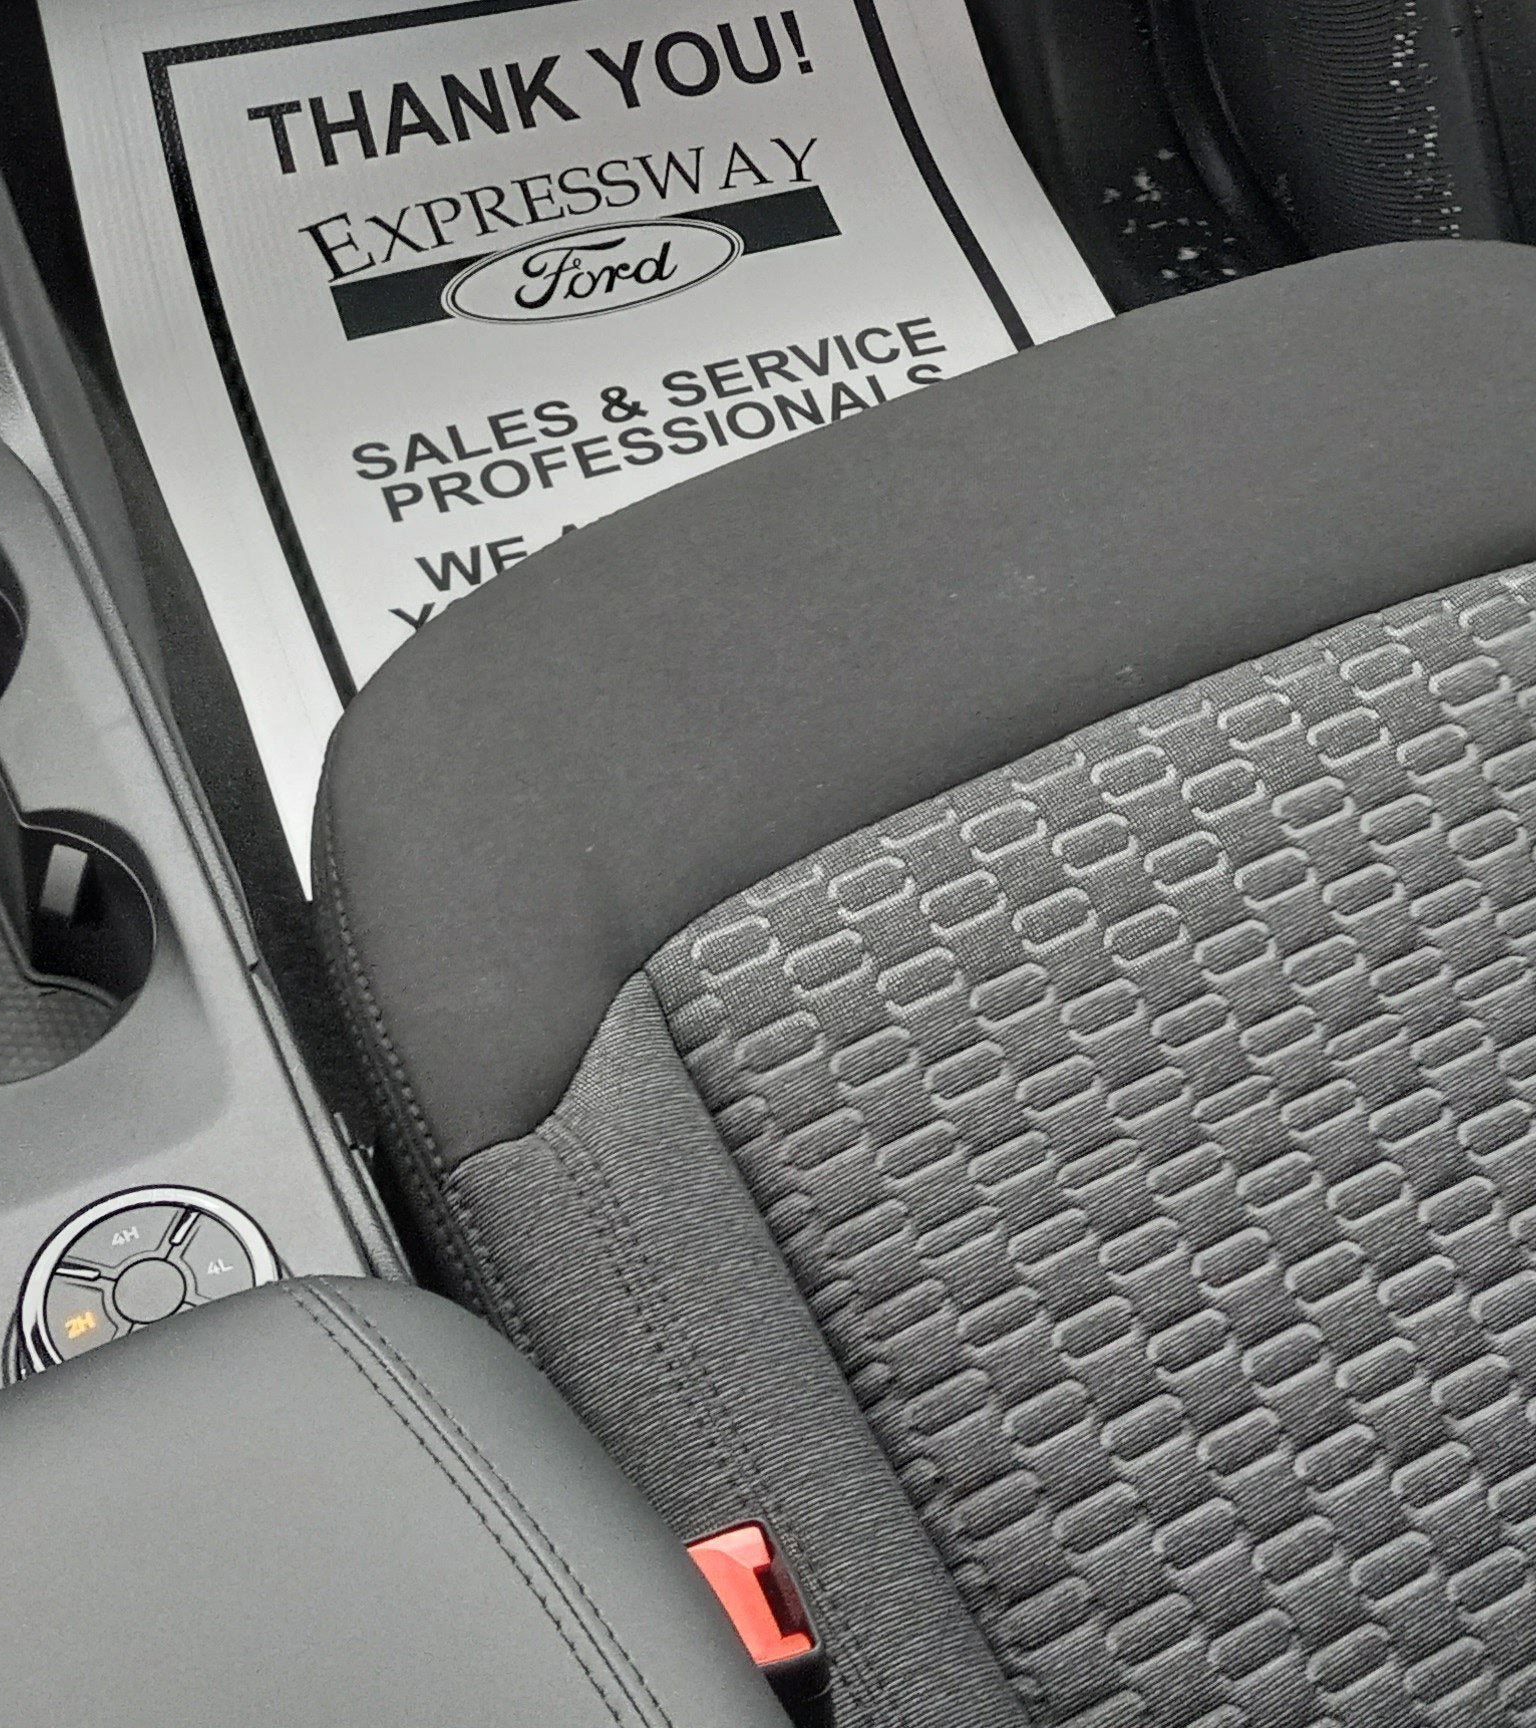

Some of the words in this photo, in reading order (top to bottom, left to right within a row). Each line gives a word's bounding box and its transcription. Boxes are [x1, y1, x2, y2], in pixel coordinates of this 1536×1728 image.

[247, 54, 581, 175] THANK
[585, 9, 814, 108] YOU!
[298, 136, 819, 284] EXPRESSWAY
[512, 237, 678, 311] Ford
[352, 399, 579, 481] SALES
[599, 385, 649, 424] &
[662, 317, 947, 407] SERVICE
[110, 1225, 140, 1246] 4H
[205, 1258, 234, 1276] 4L
[64, 1310, 96, 1339] 2H
